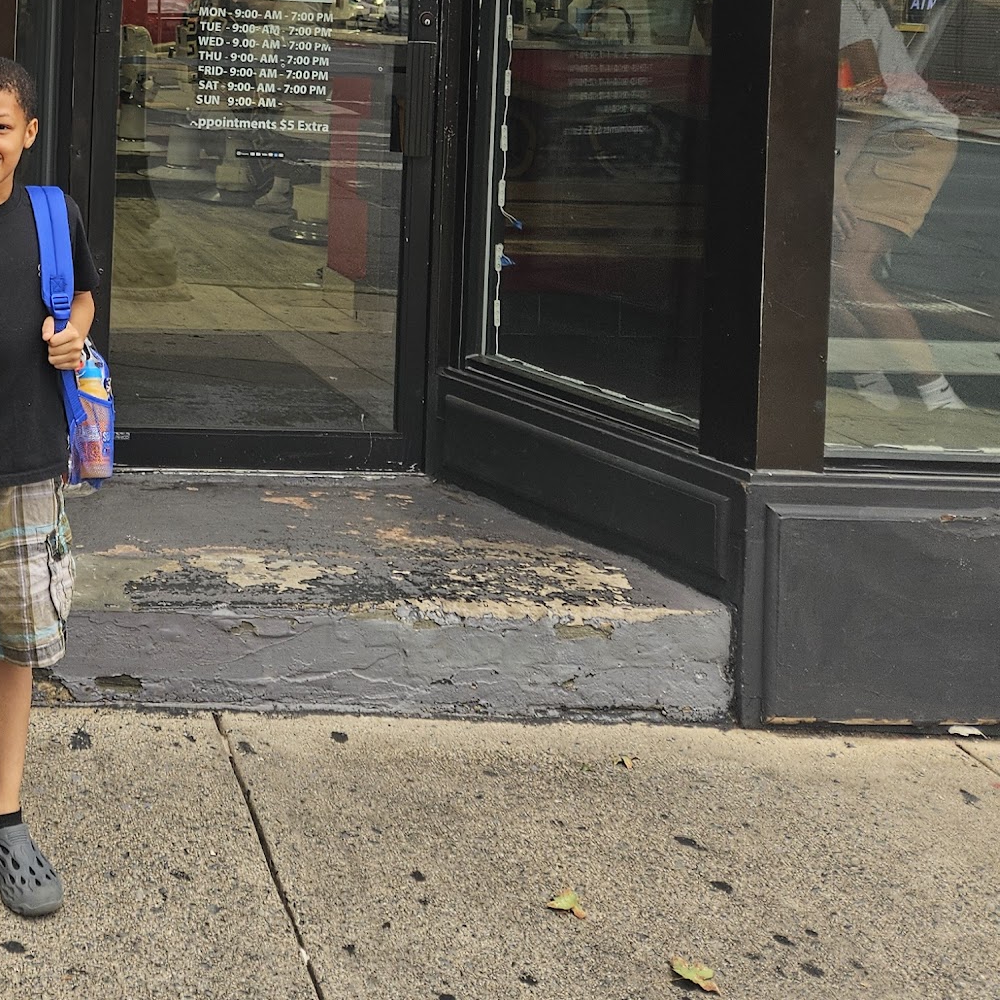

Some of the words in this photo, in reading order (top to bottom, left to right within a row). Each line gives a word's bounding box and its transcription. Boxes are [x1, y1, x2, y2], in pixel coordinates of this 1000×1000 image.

[199, 6, 226, 17] MON
[264, 10, 282, 20] AM
[291, 11, 314, 21] 7:00
[316, 12, 334, 22] PM
[200, 21, 221, 32] TUE
[262, 24, 280, 34] AM
[289, 26, 312, 36] 7:00
[313, 27, 331, 37] PM
[198, 35, 224, 47] WED
[261, 39, 280, 50] AM
[289, 40, 312, 51] 7:00
[313, 42, 332, 52] PM
[198, 51, 222, 61] THU
[259, 54, 278, 64] AM
[287, 55, 310, 65] 7:00
[312, 56, 330, 66] PM
[259, 68, 277, 79] AM
[286, 70, 310, 80] 7:00
[311, 71, 329, 81] PM
[198, 80, 219, 90] SAT
[257, 83, 276, 93] AM
[284, 84, 307, 95] 7:00
[309, 85, 327, 96] PM
[195, 95, 220, 105] SUN
[258, 98, 276, 108] AM
[279, 119, 295, 131] $5
[297, 120, 329, 132] Extra
